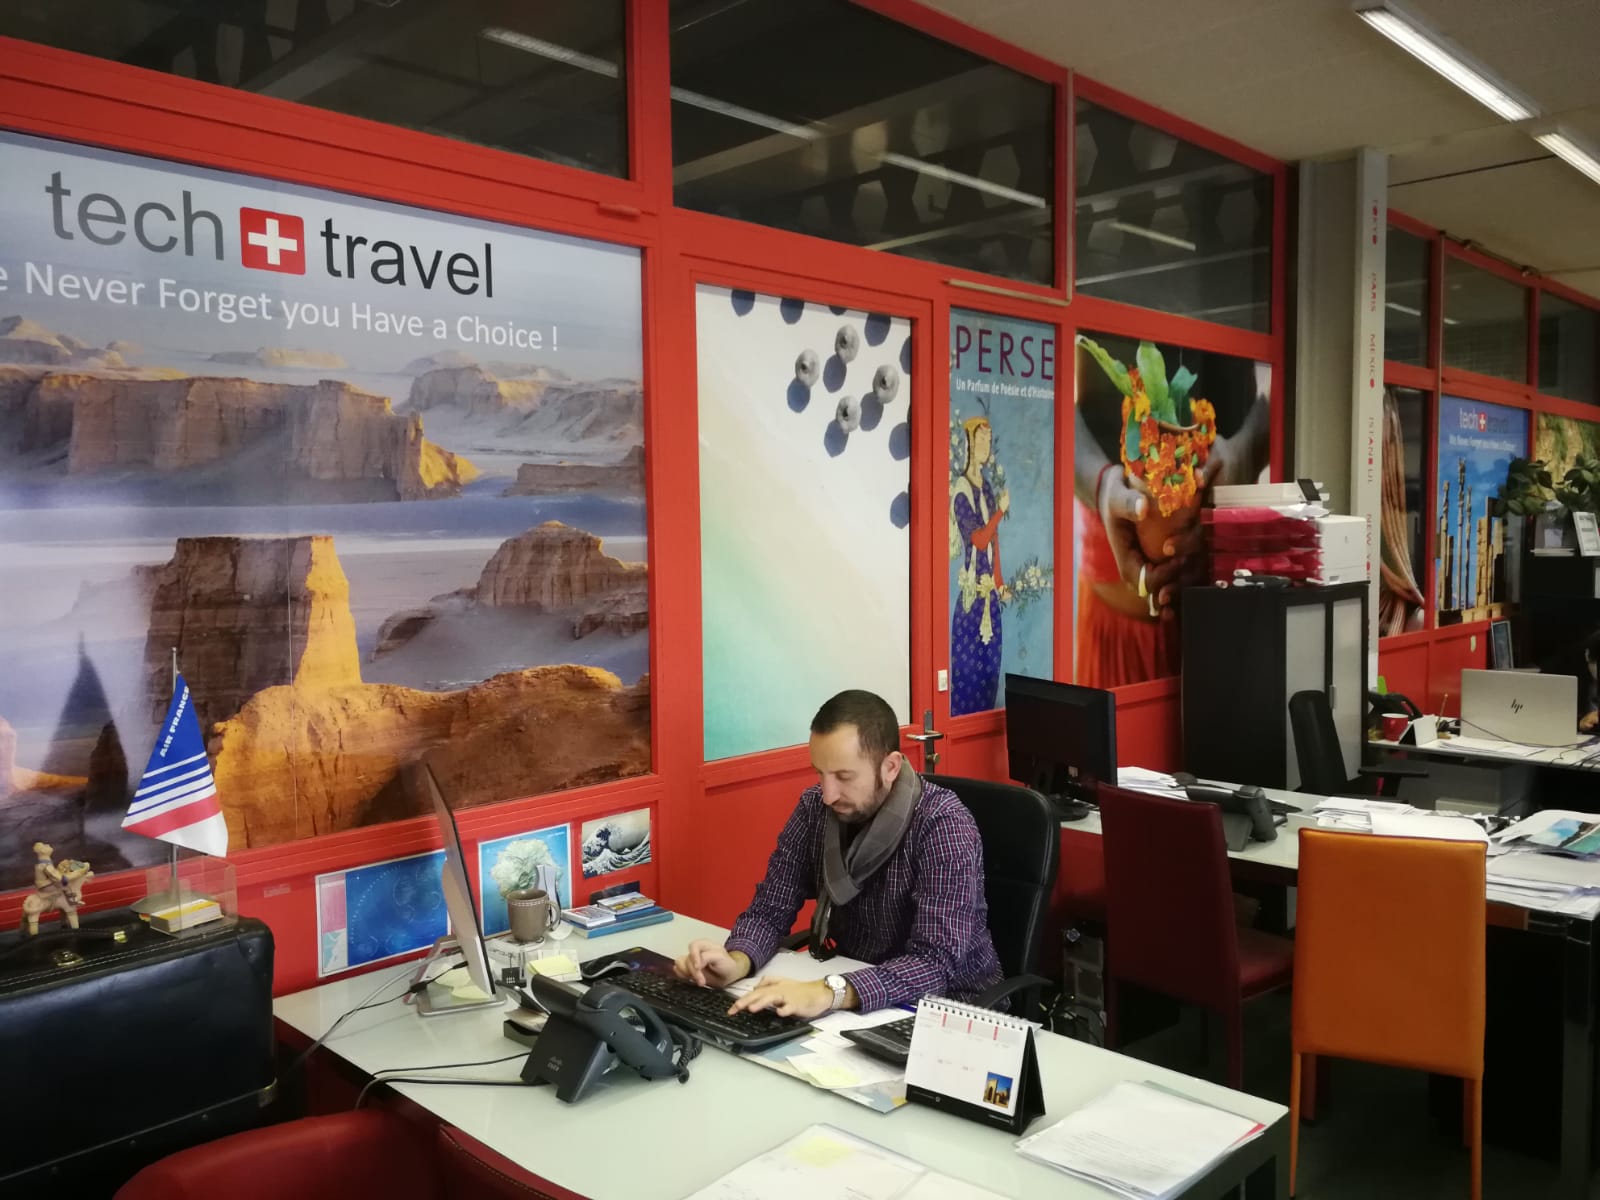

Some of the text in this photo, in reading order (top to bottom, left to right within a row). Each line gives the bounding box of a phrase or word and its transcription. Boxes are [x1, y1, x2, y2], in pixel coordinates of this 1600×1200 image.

[44, 171, 494, 298] tech travel
[25, 261, 146, 307] Never
[160, 278, 273, 324] Forget
[281, 298, 340, 330] you
[351, 303, 424, 339] Have
[432, 318, 447, 340] a
[457, 315, 543, 350] Choice
[552, 326, 558, 352] !
[956, 325, 1053, 380] PERSE
[956, 379, 966, 391] Un
[967, 379, 990, 393] Parfum
[991, 381, 1000, 395] de
[1459, 408, 1478, 430] tech
[1367, 417, 1375, 485] ISTANBUL
[160, 686, 190, 757] AIR FRANCE
